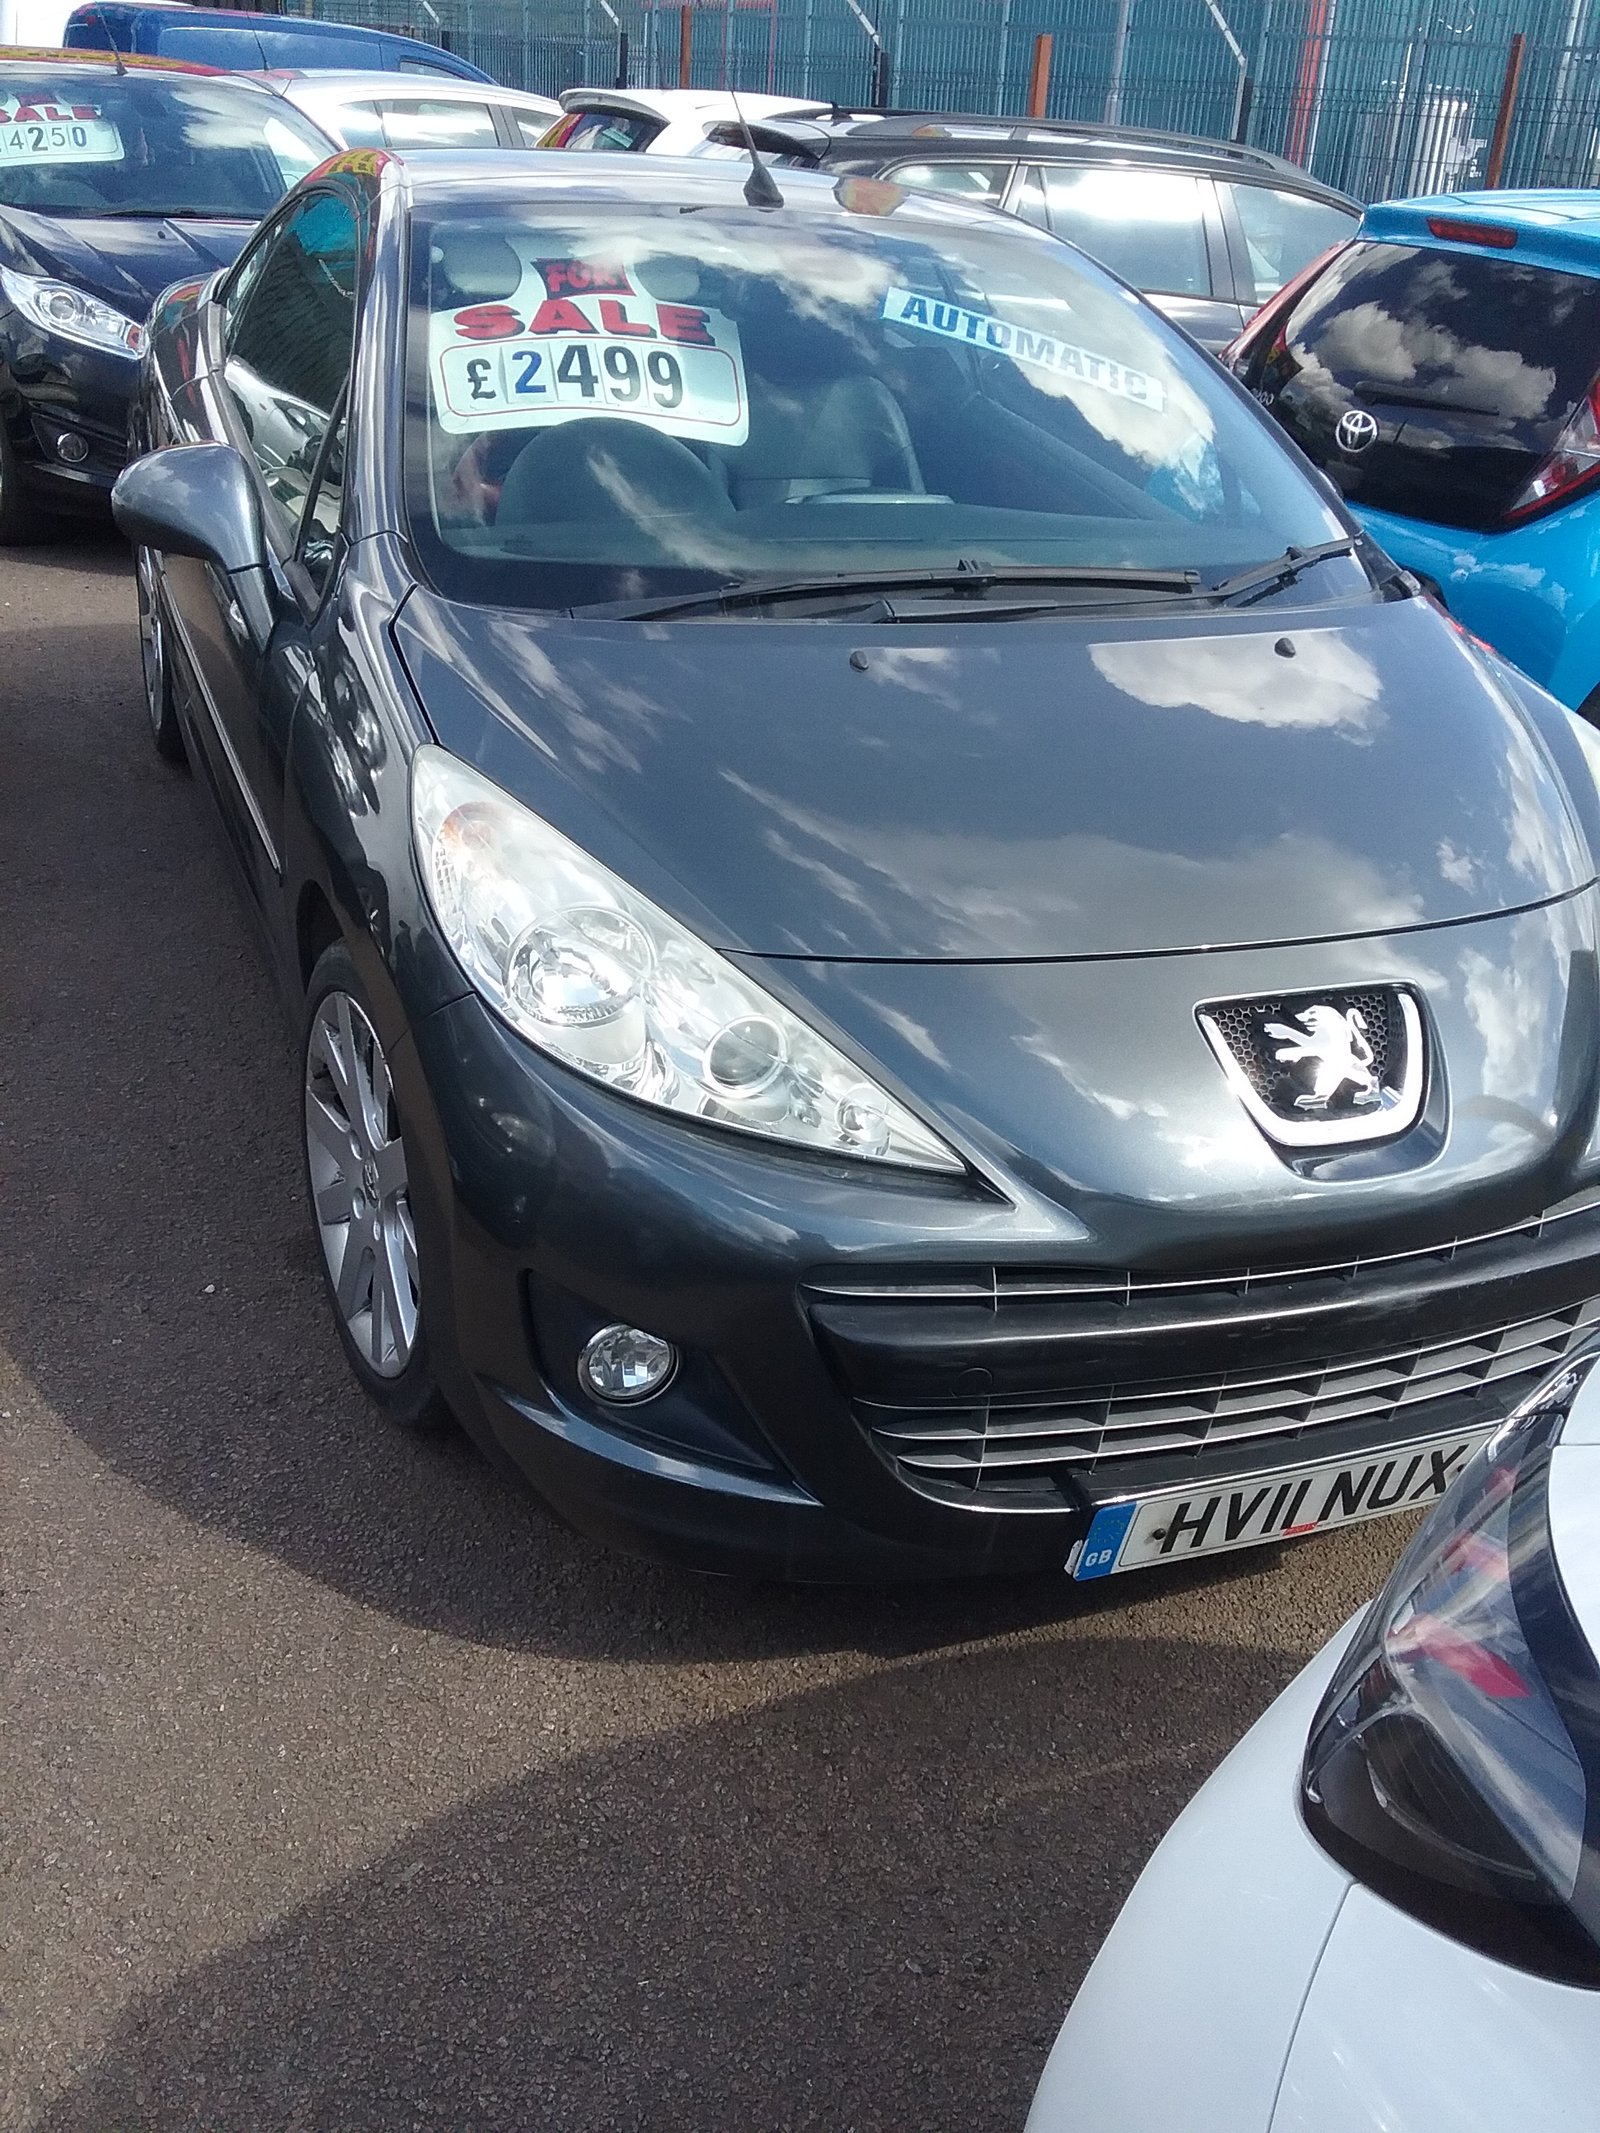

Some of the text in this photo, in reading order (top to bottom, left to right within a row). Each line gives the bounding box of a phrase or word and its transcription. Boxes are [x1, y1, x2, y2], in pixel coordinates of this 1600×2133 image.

[0, 126, 88, 152] 4250
[453, 299, 716, 346] SALE
[901, 296, 1148, 401] AUTOMATIC
[466, 344, 684, 409] £2499
[1317, 1444, 1470, 1523] NUX
[1085, 1549, 1113, 1567] GB
